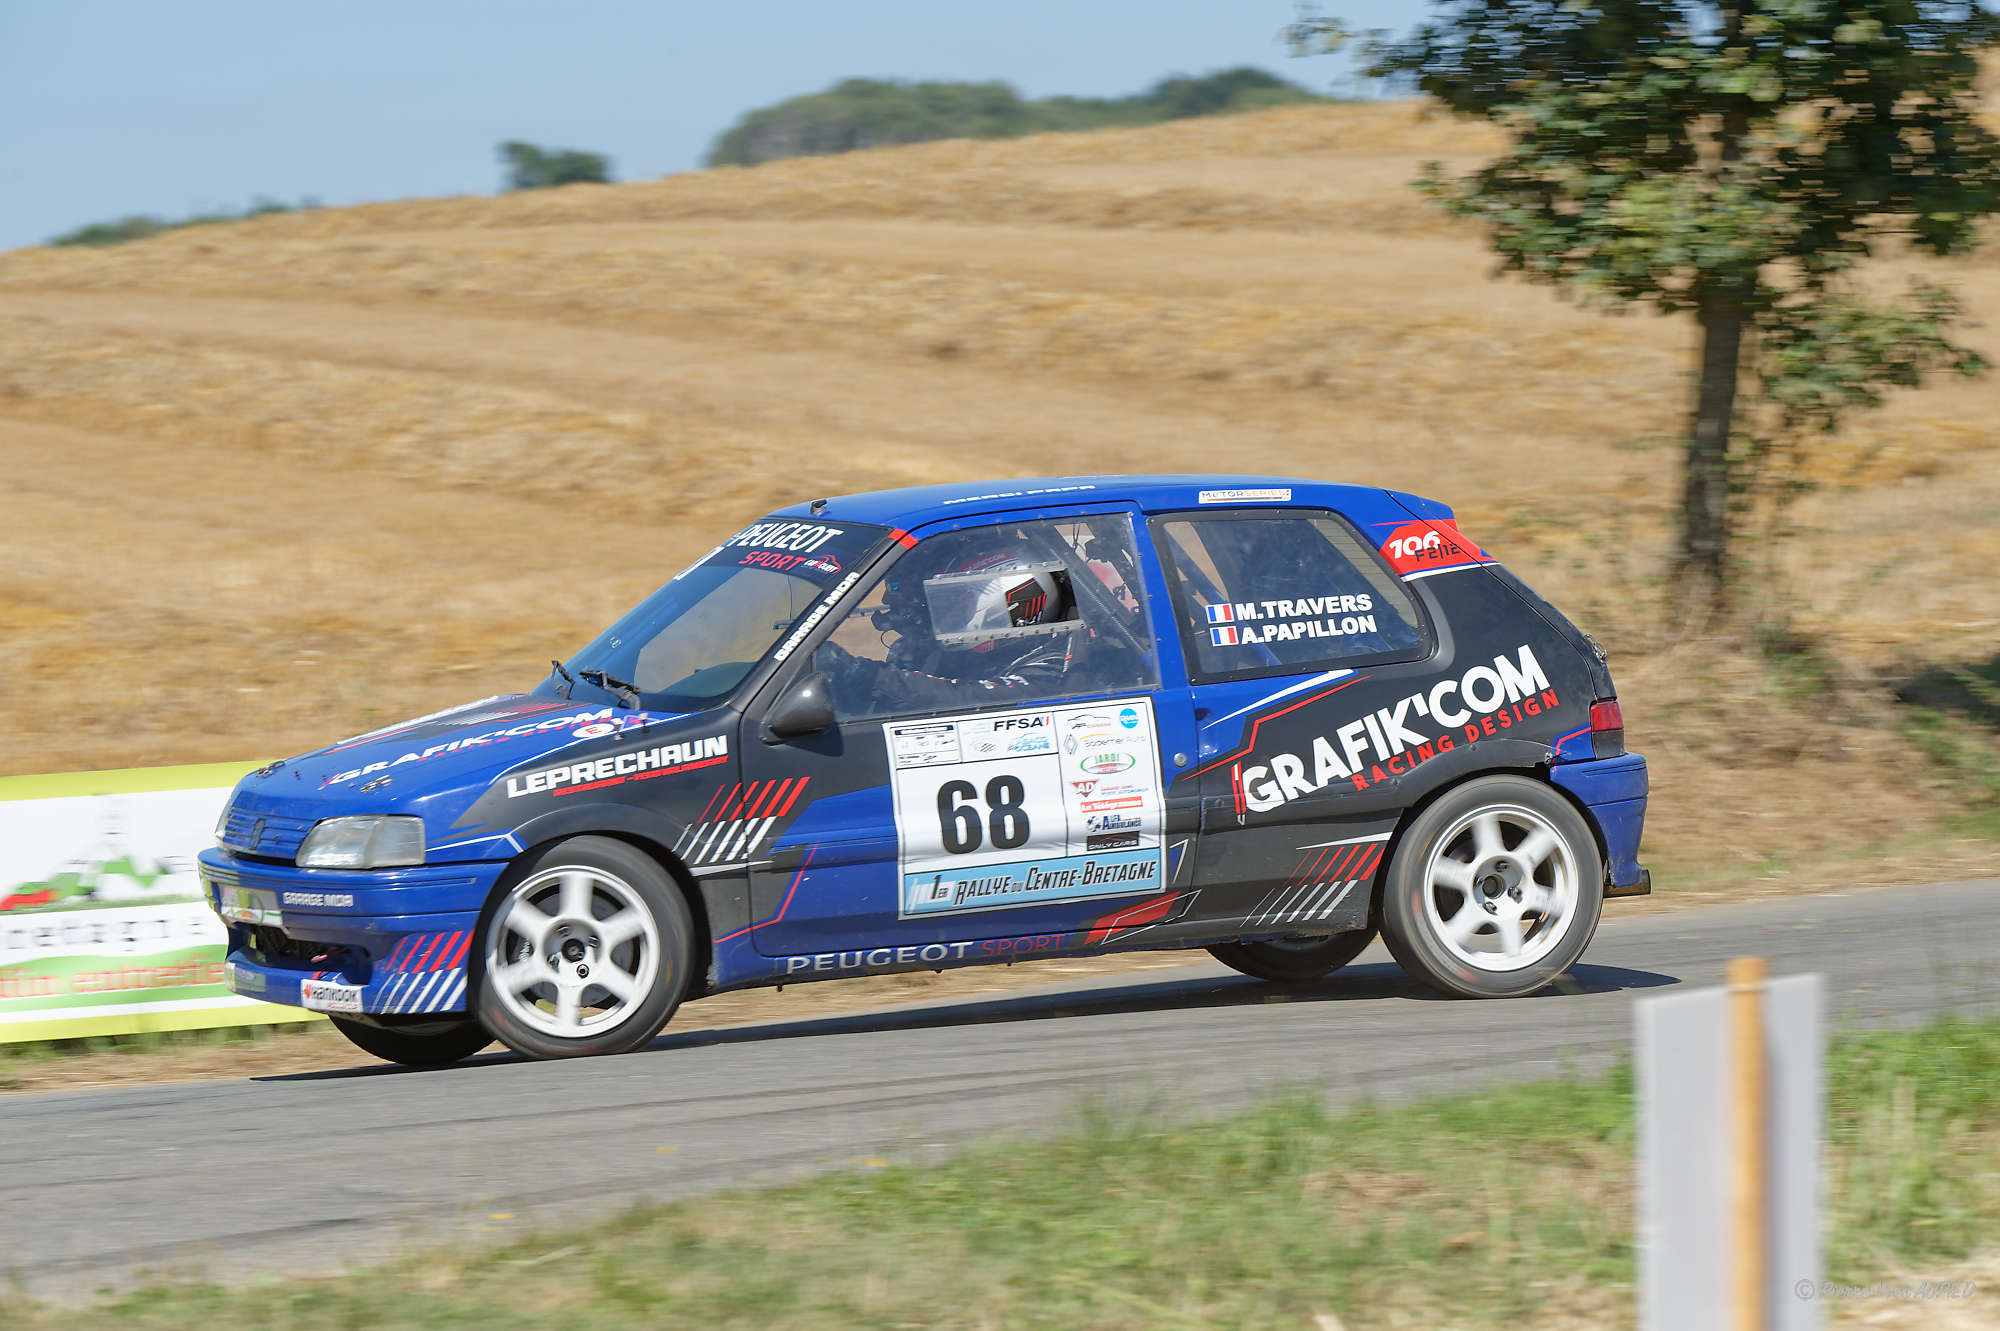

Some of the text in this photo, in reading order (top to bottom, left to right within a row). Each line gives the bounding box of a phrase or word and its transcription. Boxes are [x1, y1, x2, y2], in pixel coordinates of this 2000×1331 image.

[726, 522, 844, 553] PEUGEOT
[1388, 530, 1441, 560] 106
[738, 551, 807, 571] SPORT
[1235, 593, 1374, 621] M.TRAVERS
[1241, 614, 1378, 645] A.PAPILLON
[993, 716, 1043, 732] FFSA
[1241, 644, 1552, 812] GRAFIK'COM
[1351, 688, 1560, 791] RACING DESIGN
[330, 706, 614, 786] GRAFIK'COM
[506, 734, 728, 799] LEPRECHAUN
[1076, 781, 1094, 794] AD
[936, 774, 1030, 855] 68
[953, 875, 1012, 905] RALLYE
[786, 934, 1067, 975] PEUGEOT SPORT
